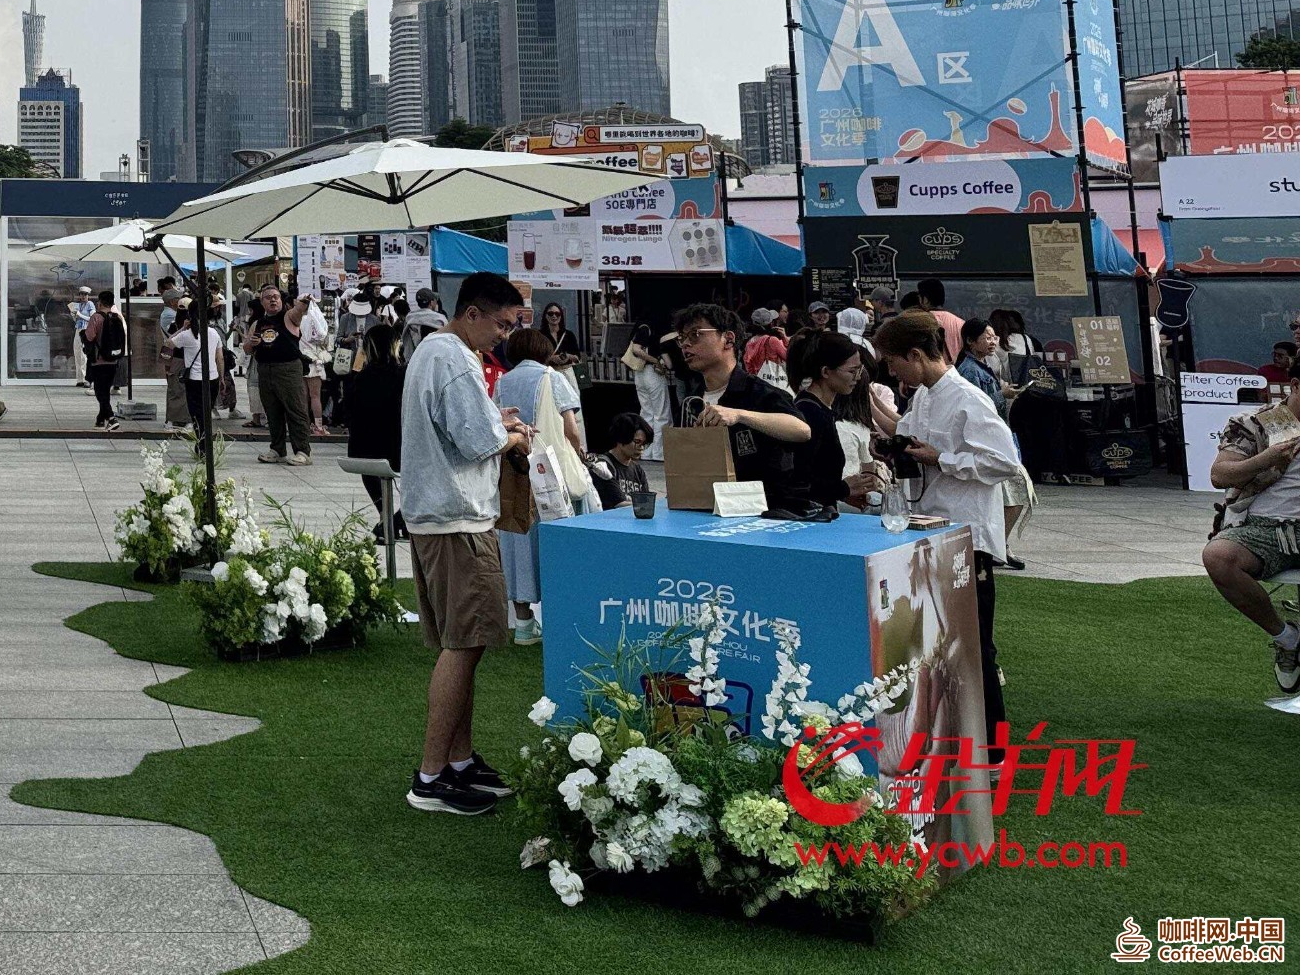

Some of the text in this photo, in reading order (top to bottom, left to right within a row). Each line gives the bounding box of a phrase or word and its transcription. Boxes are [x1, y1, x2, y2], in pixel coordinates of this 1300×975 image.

[936, 51, 973, 85] 区
[819, 107, 863, 119] 2026
[909, 181, 1014, 198] Cupps Coffee
[602, 235, 663, 244] Nitrogen Lungo
[811, 268, 820, 292] MENU
[1090, 320, 1103, 330] 01
[1095, 355, 1111, 366] 02
[1183, 375, 1260, 386] Filter Coffee
[1183, 388, 1234, 400] product
[657, 577, 736, 605] 2026
[734, 651, 761, 664] FAIR
